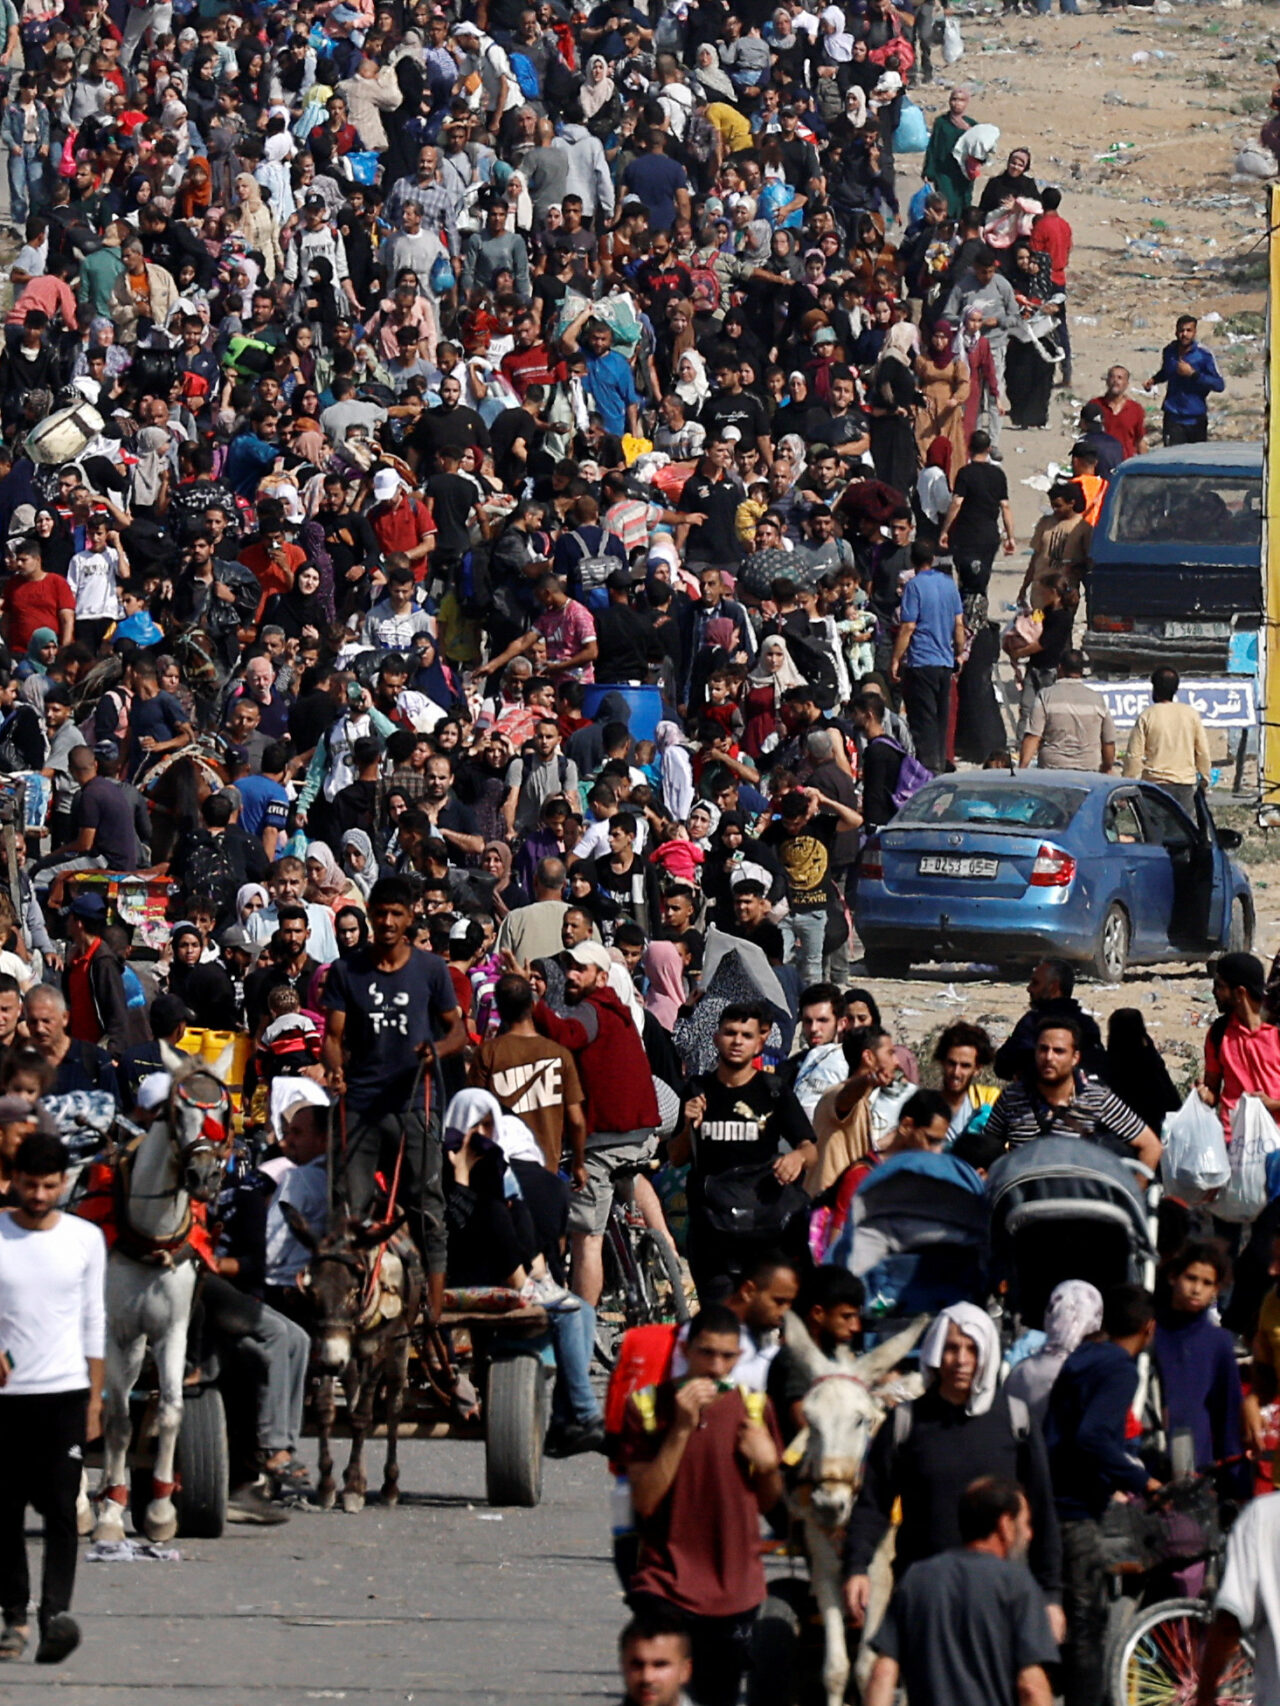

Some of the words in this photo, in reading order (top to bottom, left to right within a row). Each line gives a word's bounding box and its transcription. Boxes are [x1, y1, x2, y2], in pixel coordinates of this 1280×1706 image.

[1103, 694, 1150, 716] LICE
[1174, 690, 1241, 718] شرط
[701, 1120, 760, 1142] PUMA
